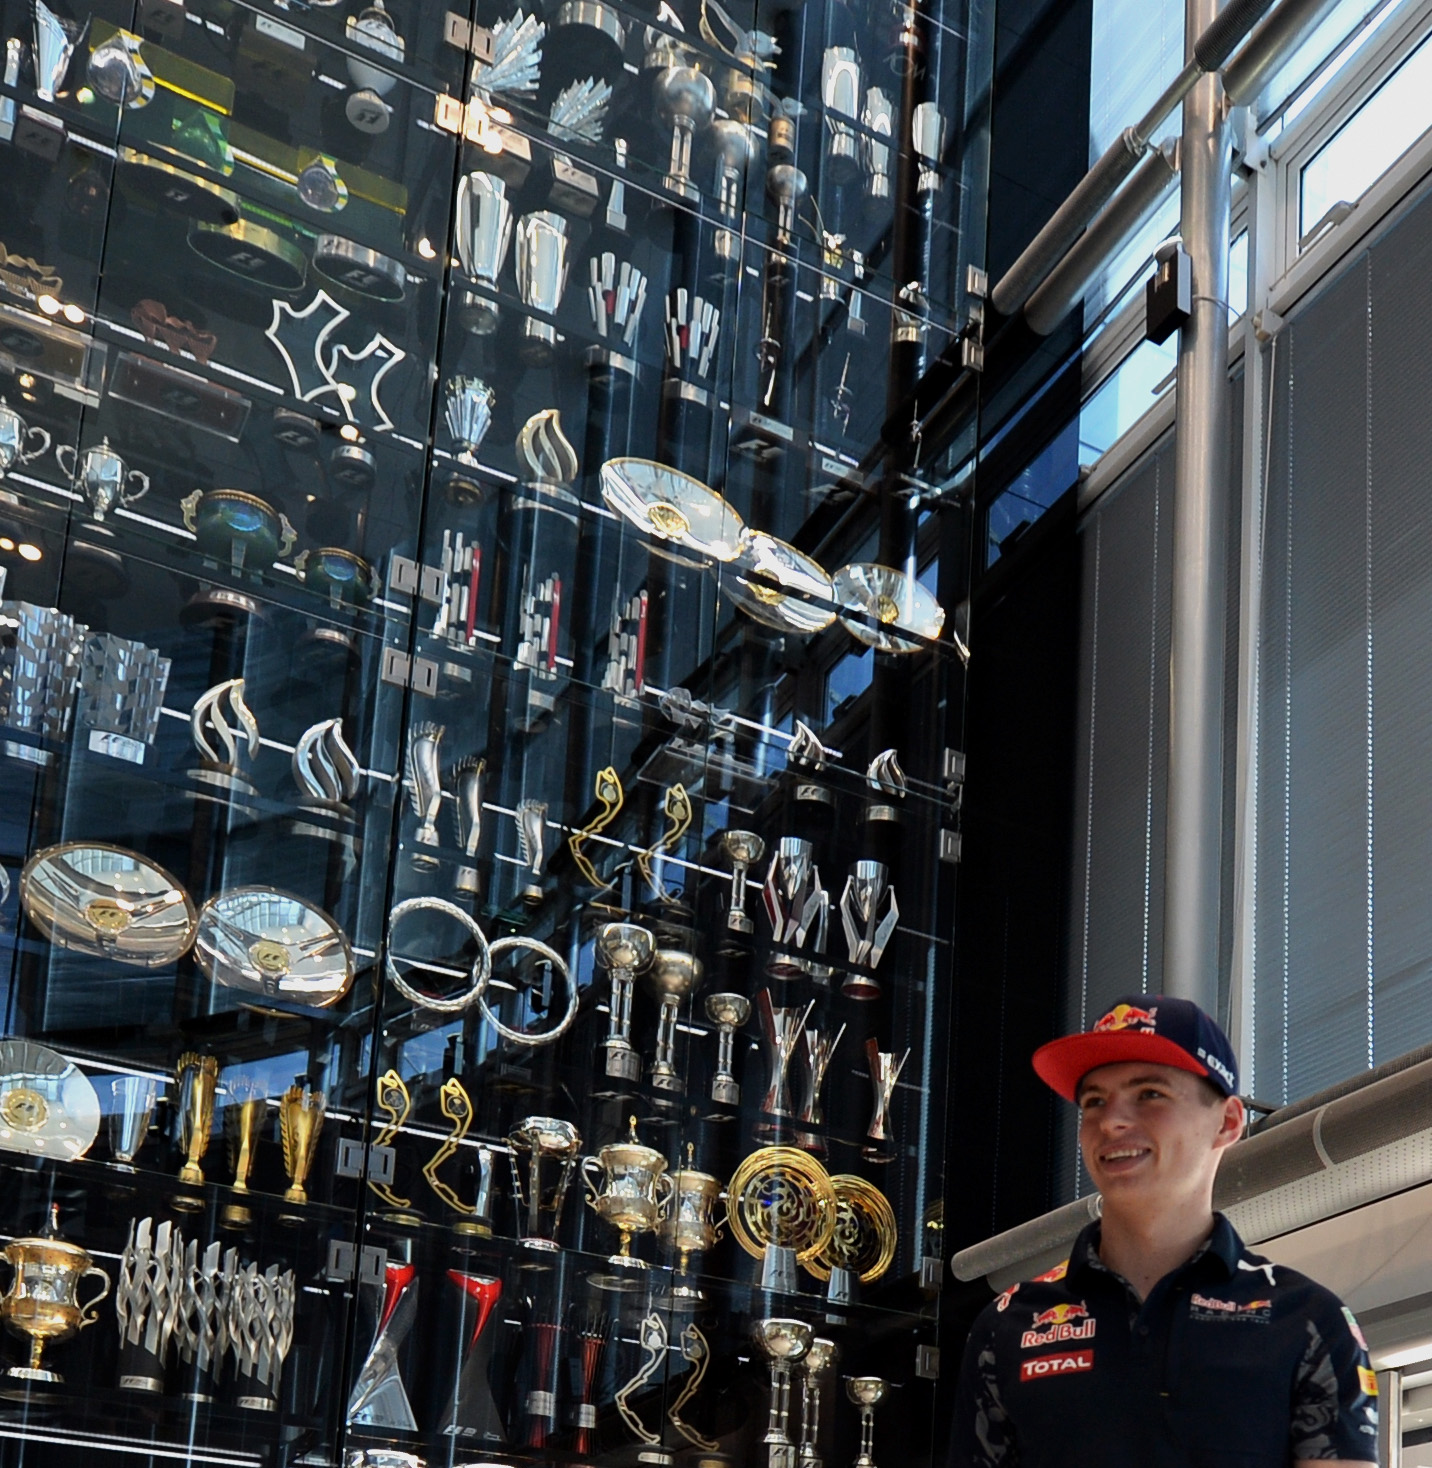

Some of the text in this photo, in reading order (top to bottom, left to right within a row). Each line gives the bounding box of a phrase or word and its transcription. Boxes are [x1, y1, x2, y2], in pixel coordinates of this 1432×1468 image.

[1021, 1319, 1096, 1348] Red Bull
[1023, 1357, 1091, 1376] TOTAL
